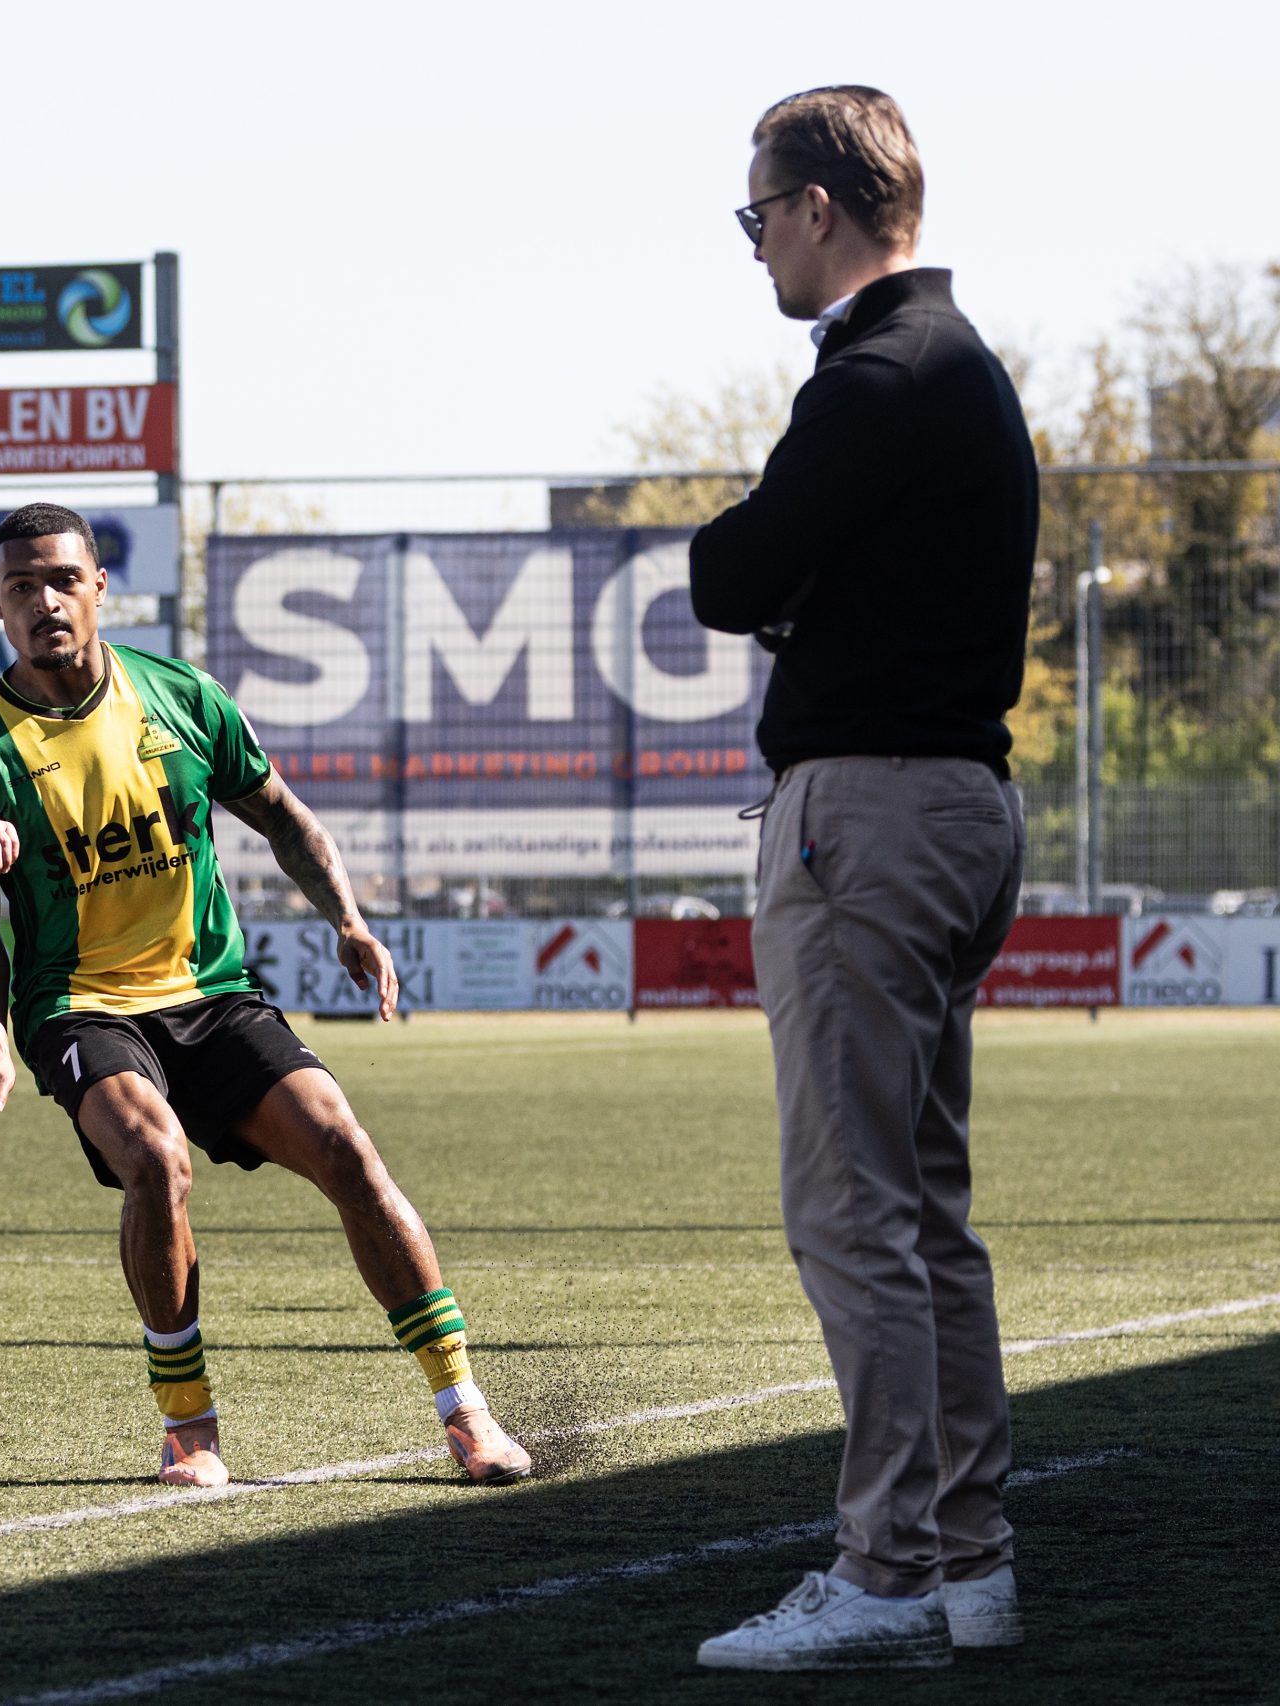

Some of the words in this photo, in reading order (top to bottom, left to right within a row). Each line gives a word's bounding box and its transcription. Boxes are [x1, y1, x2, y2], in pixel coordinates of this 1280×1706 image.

[86, 388, 150, 441] BV
[232, 540, 753, 726] SMG
[268, 753, 356, 780] ALES
[371, 751, 597, 779] MARKETING
[612, 748, 748, 778] GROUP
[42, 785, 202, 881] sterk
[297, 924, 424, 962] SUHI
[535, 982, 626, 1004] meco
[1130, 979, 1221, 1003] meco
